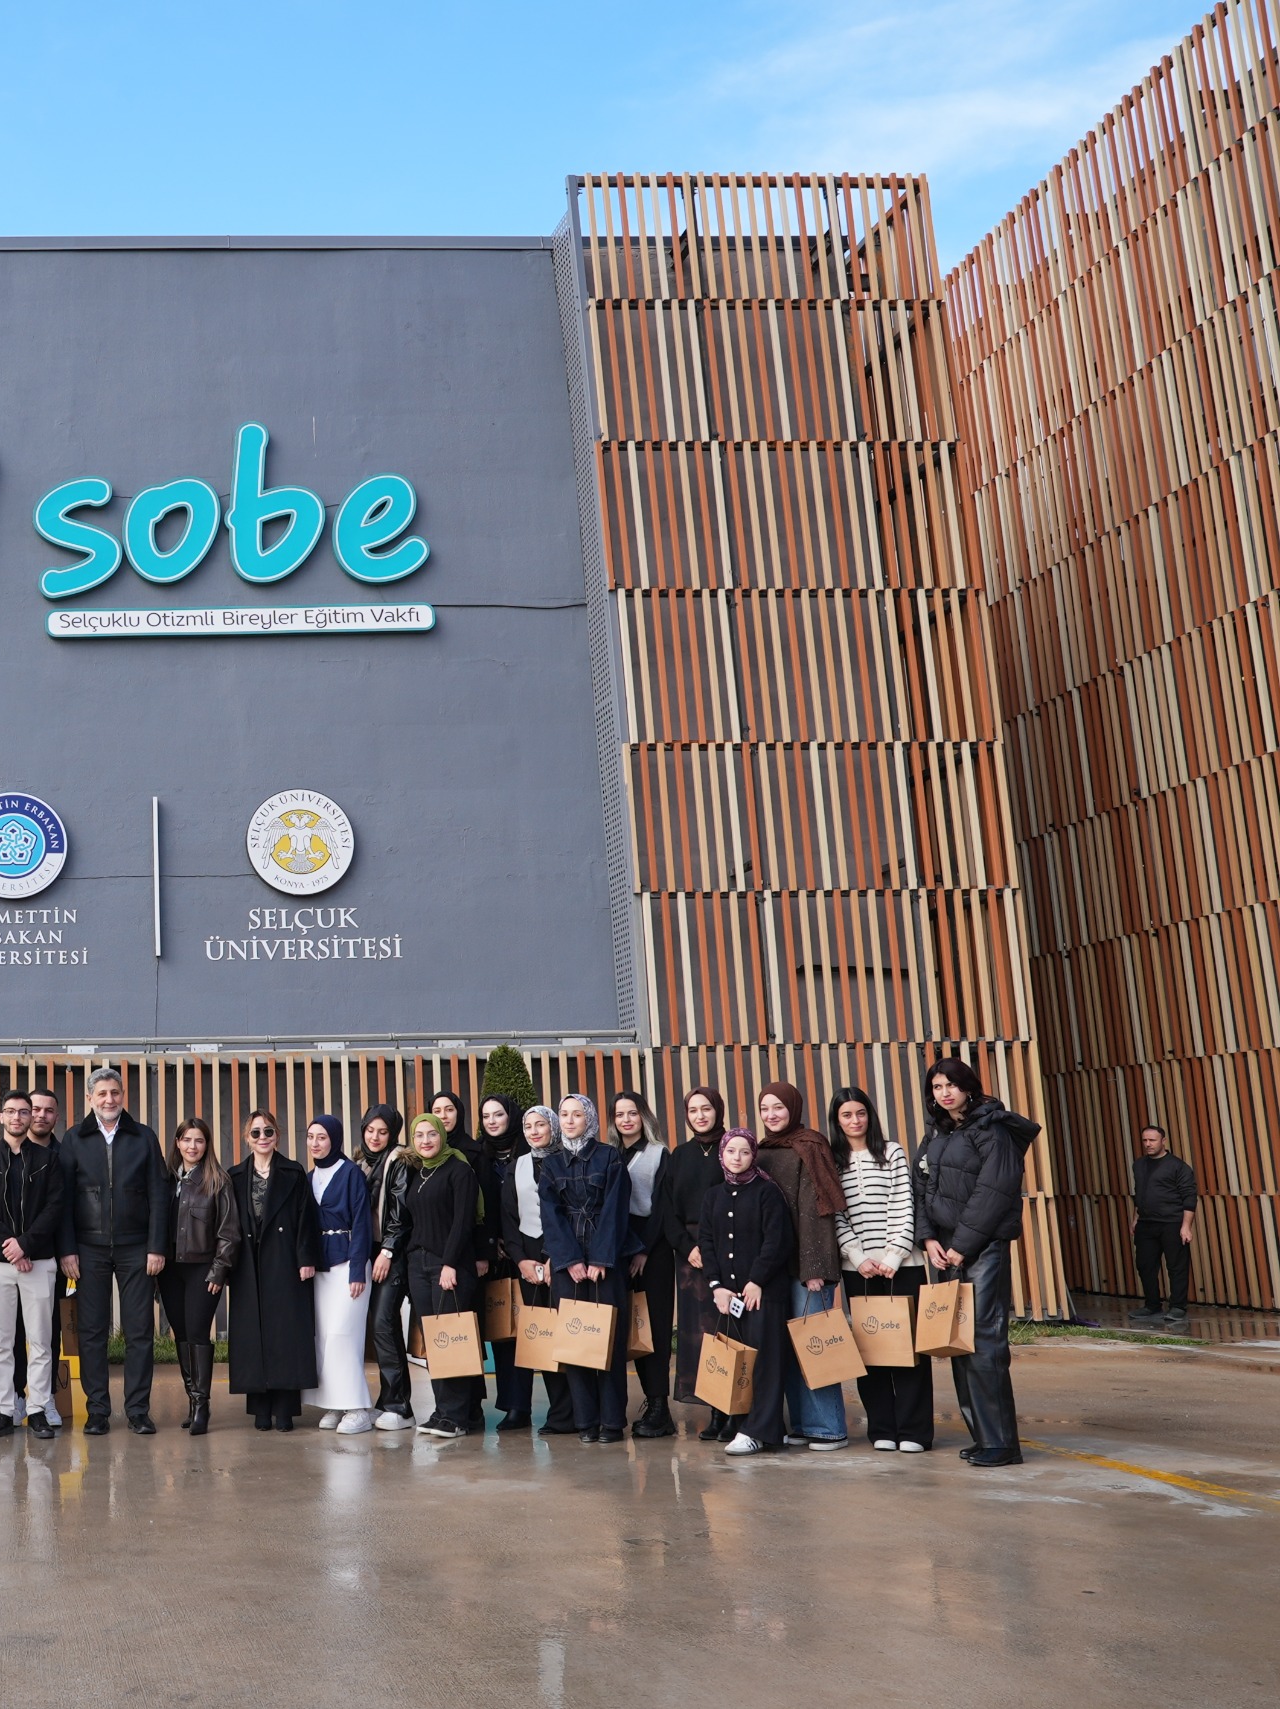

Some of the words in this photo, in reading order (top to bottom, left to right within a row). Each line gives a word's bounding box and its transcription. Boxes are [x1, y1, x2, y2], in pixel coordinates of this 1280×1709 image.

[33, 421, 430, 598] sobe
[59, 611, 140, 632] Selçuklu
[146, 611, 214, 627] Otizmli
[222, 610, 299, 629] Bireyler
[304, 608, 365, 628] Eğitim
[370, 607, 421, 623] Vakfı
[24, 802, 59, 849] ERBAKAN
[251, 800, 278, 848] SELÇUK
[279, 791, 352, 849] ÜNİVERSİTESİ
[274, 874, 305, 889] KONYA
[311, 874, 329, 887] 1975
[248, 907, 359, 935] SELÇUK
[204, 934, 403, 961] ÜNİVERSİTESİ
[538, 1329, 553, 1337] sobe
[583, 1324, 601, 1334] sobe
[880, 1320, 900, 1330] sobe
[450, 1333, 468, 1343] sobe
[825, 1335, 844, 1346] sobe
